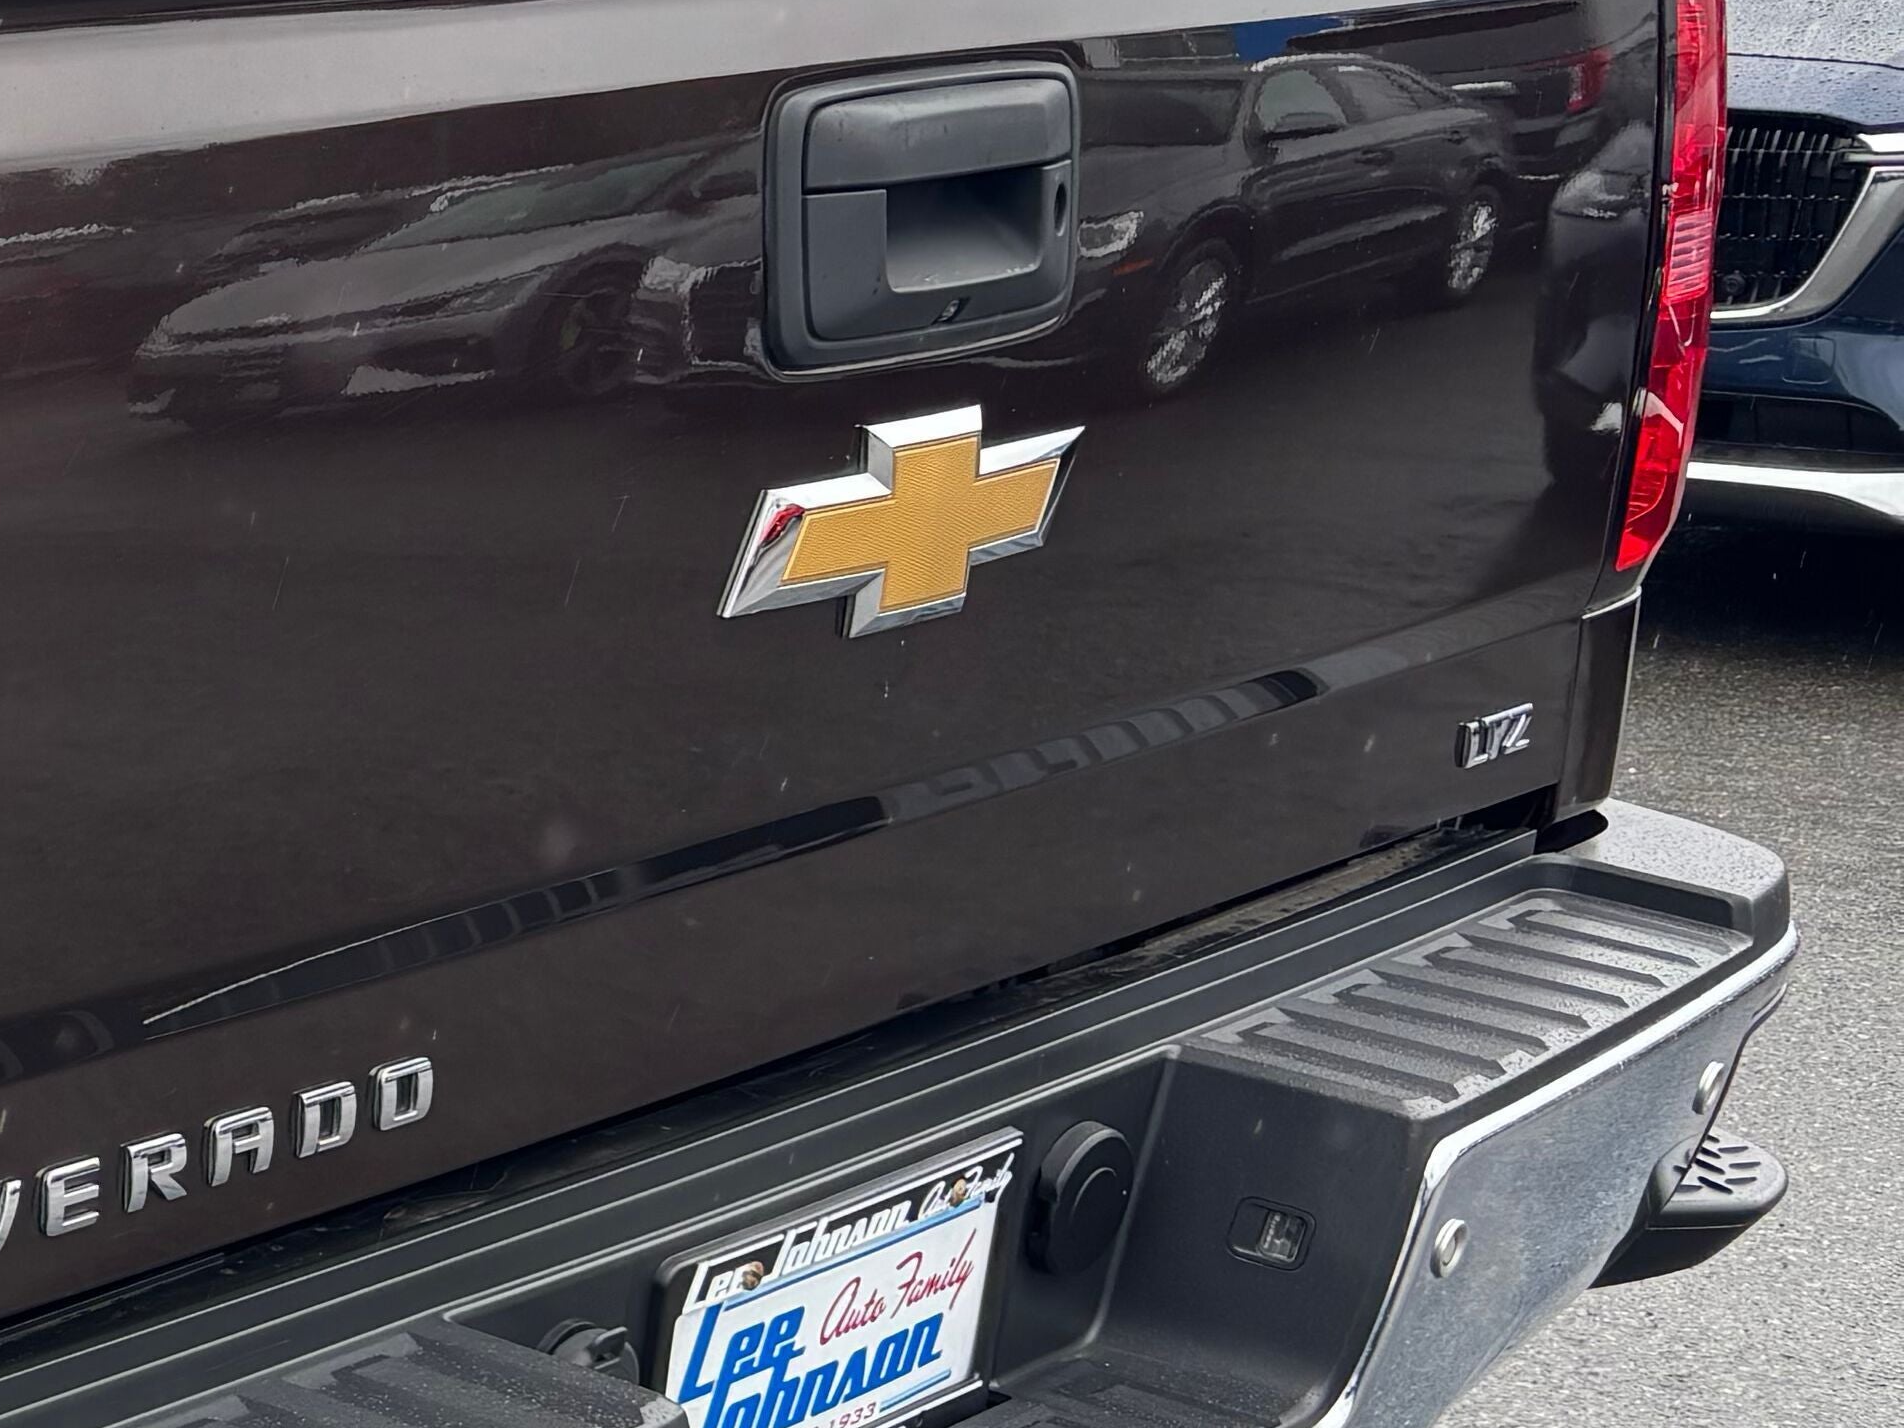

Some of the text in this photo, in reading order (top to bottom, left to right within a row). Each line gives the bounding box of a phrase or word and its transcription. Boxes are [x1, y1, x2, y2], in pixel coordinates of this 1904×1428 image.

[1454, 702, 1533, 769] LTZ
[770, 1200, 912, 1280] Johnson
[819, 1229, 978, 1346] Auto Family
[678, 1302, 805, 1405] Lee
